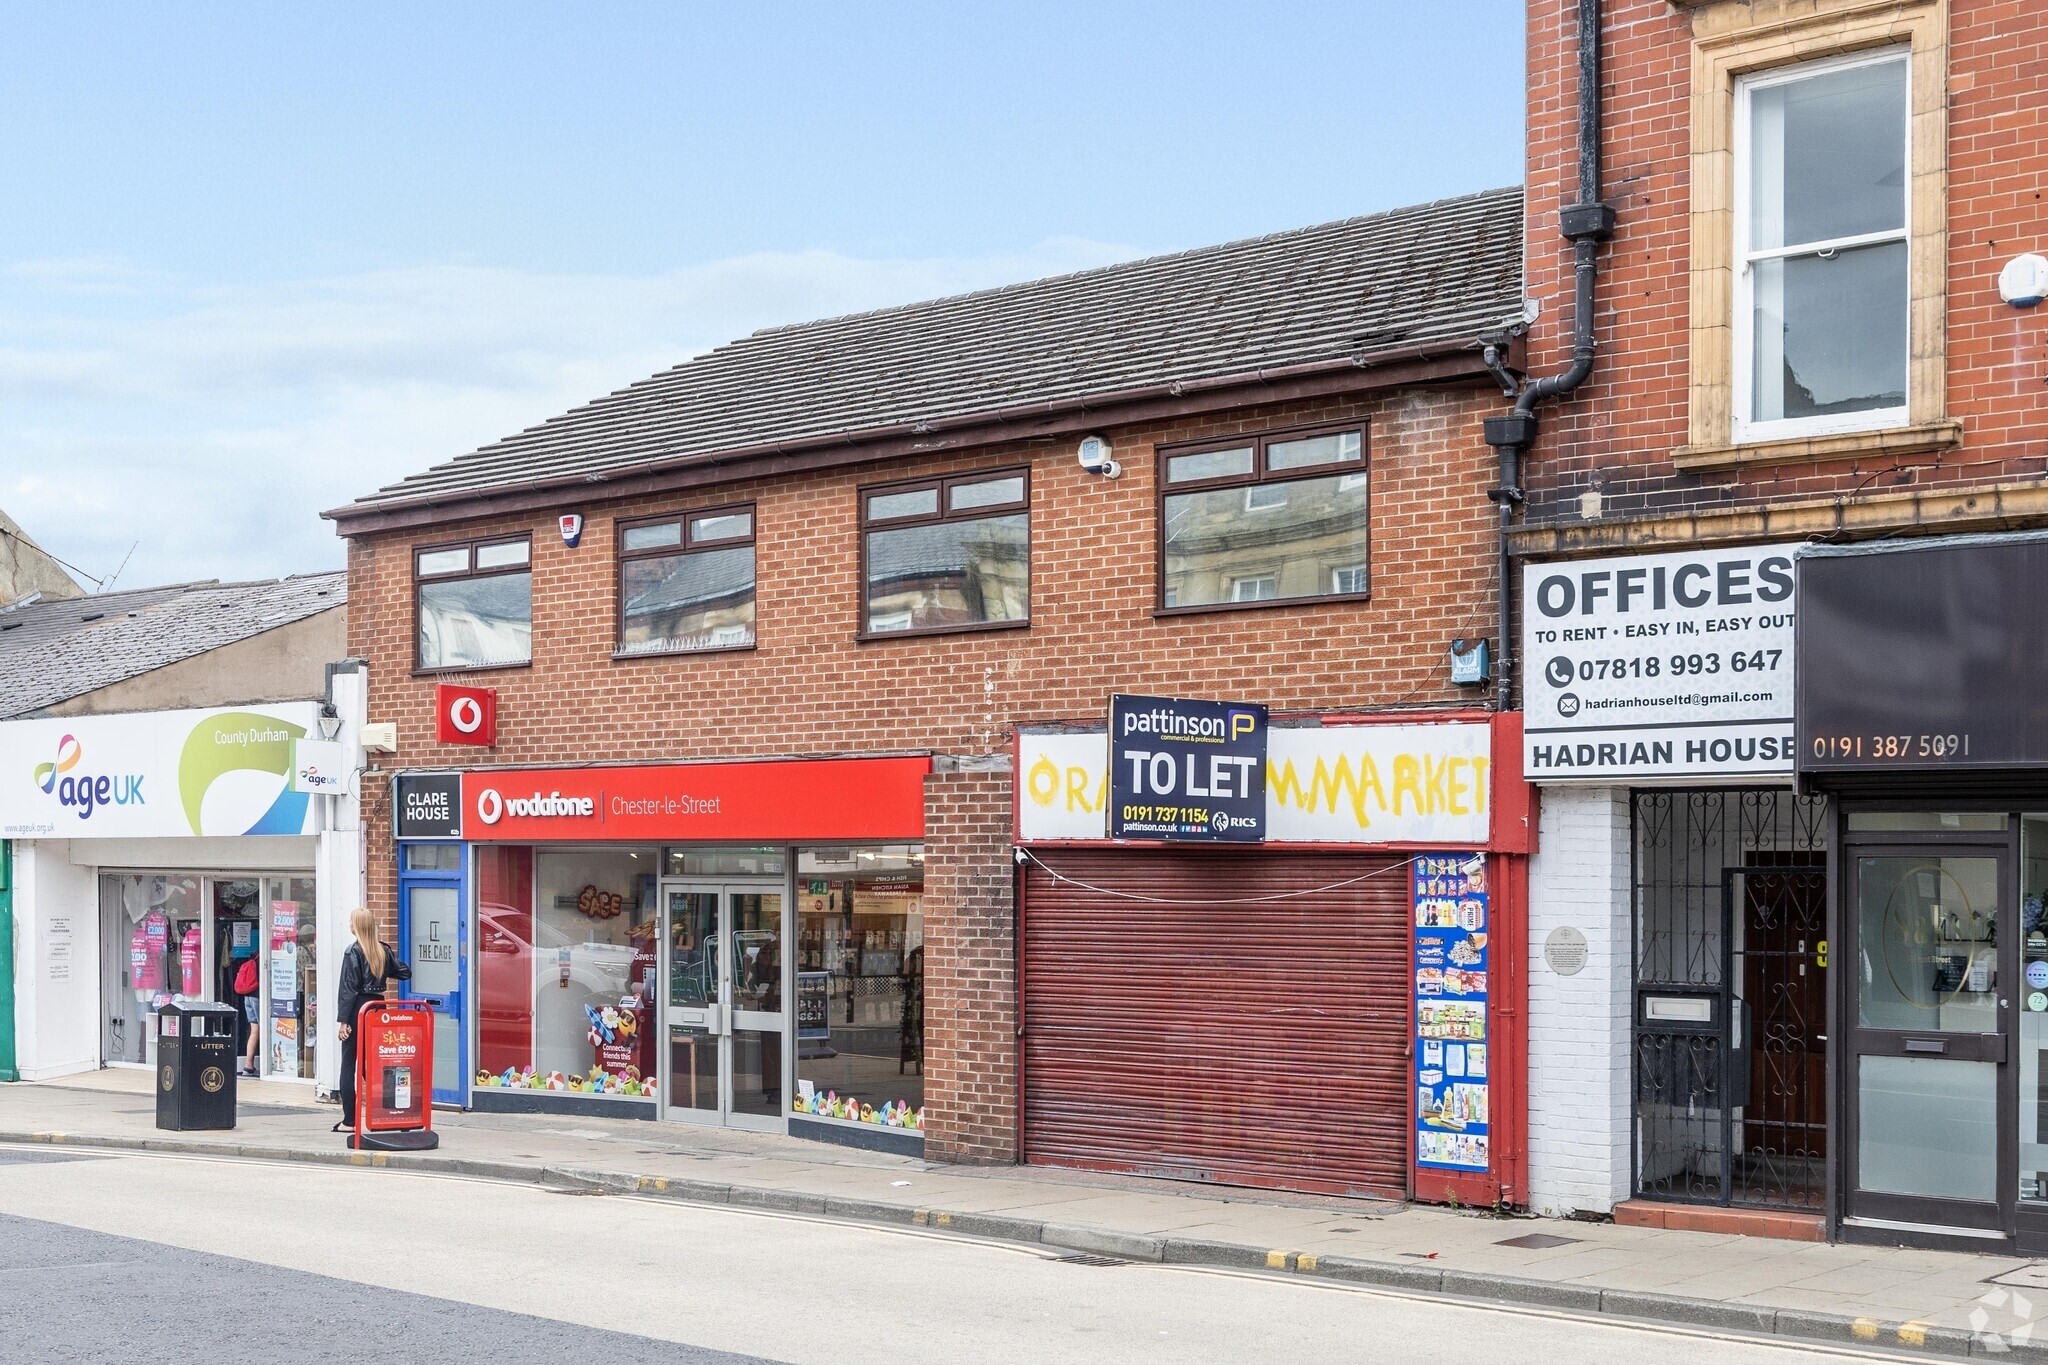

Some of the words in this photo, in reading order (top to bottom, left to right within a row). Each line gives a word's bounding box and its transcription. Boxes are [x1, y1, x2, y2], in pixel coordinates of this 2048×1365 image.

[1537, 556, 1794, 618] OFFICES
[1535, 630, 1557, 644] TO
[1563, 627, 1607, 642] RENT
[1625, 622, 1671, 638] EASY
[1676, 621, 1700, 637] IN,
[1705, 616, 1753, 633] EASY
[1758, 614, 1795, 629] OUT
[1453, 666, 1480, 675] ALARM
[1578, 656, 1660, 681] 07818
[1670, 652, 1721, 676] 993
[1731, 649, 1783, 673] 647
[1585, 691, 1773, 710] hadrianhouseltd@gmail.com
[1124, 708, 1225, 737] pattinson
[214, 730, 248, 747] County
[249, 727, 289, 743] Durham
[1195, 735, 1225, 744] professional
[1533, 741, 1674, 768] HADRIAN
[1685, 736, 1795, 763] HOUSE
[1813, 737, 1862, 759] 0191
[1872, 735, 1912, 758] 387
[1918, 734, 1969, 757] 5091
[1124, 750, 1177, 795] TO
[1186, 753, 1257, 799] LET
[407, 792, 448, 806] CLARE
[505, 791, 594, 817] vodafone
[611, 795, 721, 815] Chester-le-Street
[406, 807, 450, 821] HOUSE
[1123, 805, 1152, 821] 0191
[1155, 806, 1178, 822] 737
[1180, 808, 1209, 823] 1154
[4, 823, 55, 834] www.ageuk.org.uk
[1123, 821, 1178, 833] pattinson.co.uk
[1230, 817, 1257, 828] RICS
[419, 944, 431, 959] THE
[434, 945, 452, 960] CAGE
[634, 951, 650, 961] Save
[2033, 995, 2043, 1004] 72
[378, 1045, 397, 1054] Save
[398, 1045, 416, 1054] £910
[602, 1043, 631, 1054] Connecting
[603, 1051, 621, 1060] friends
